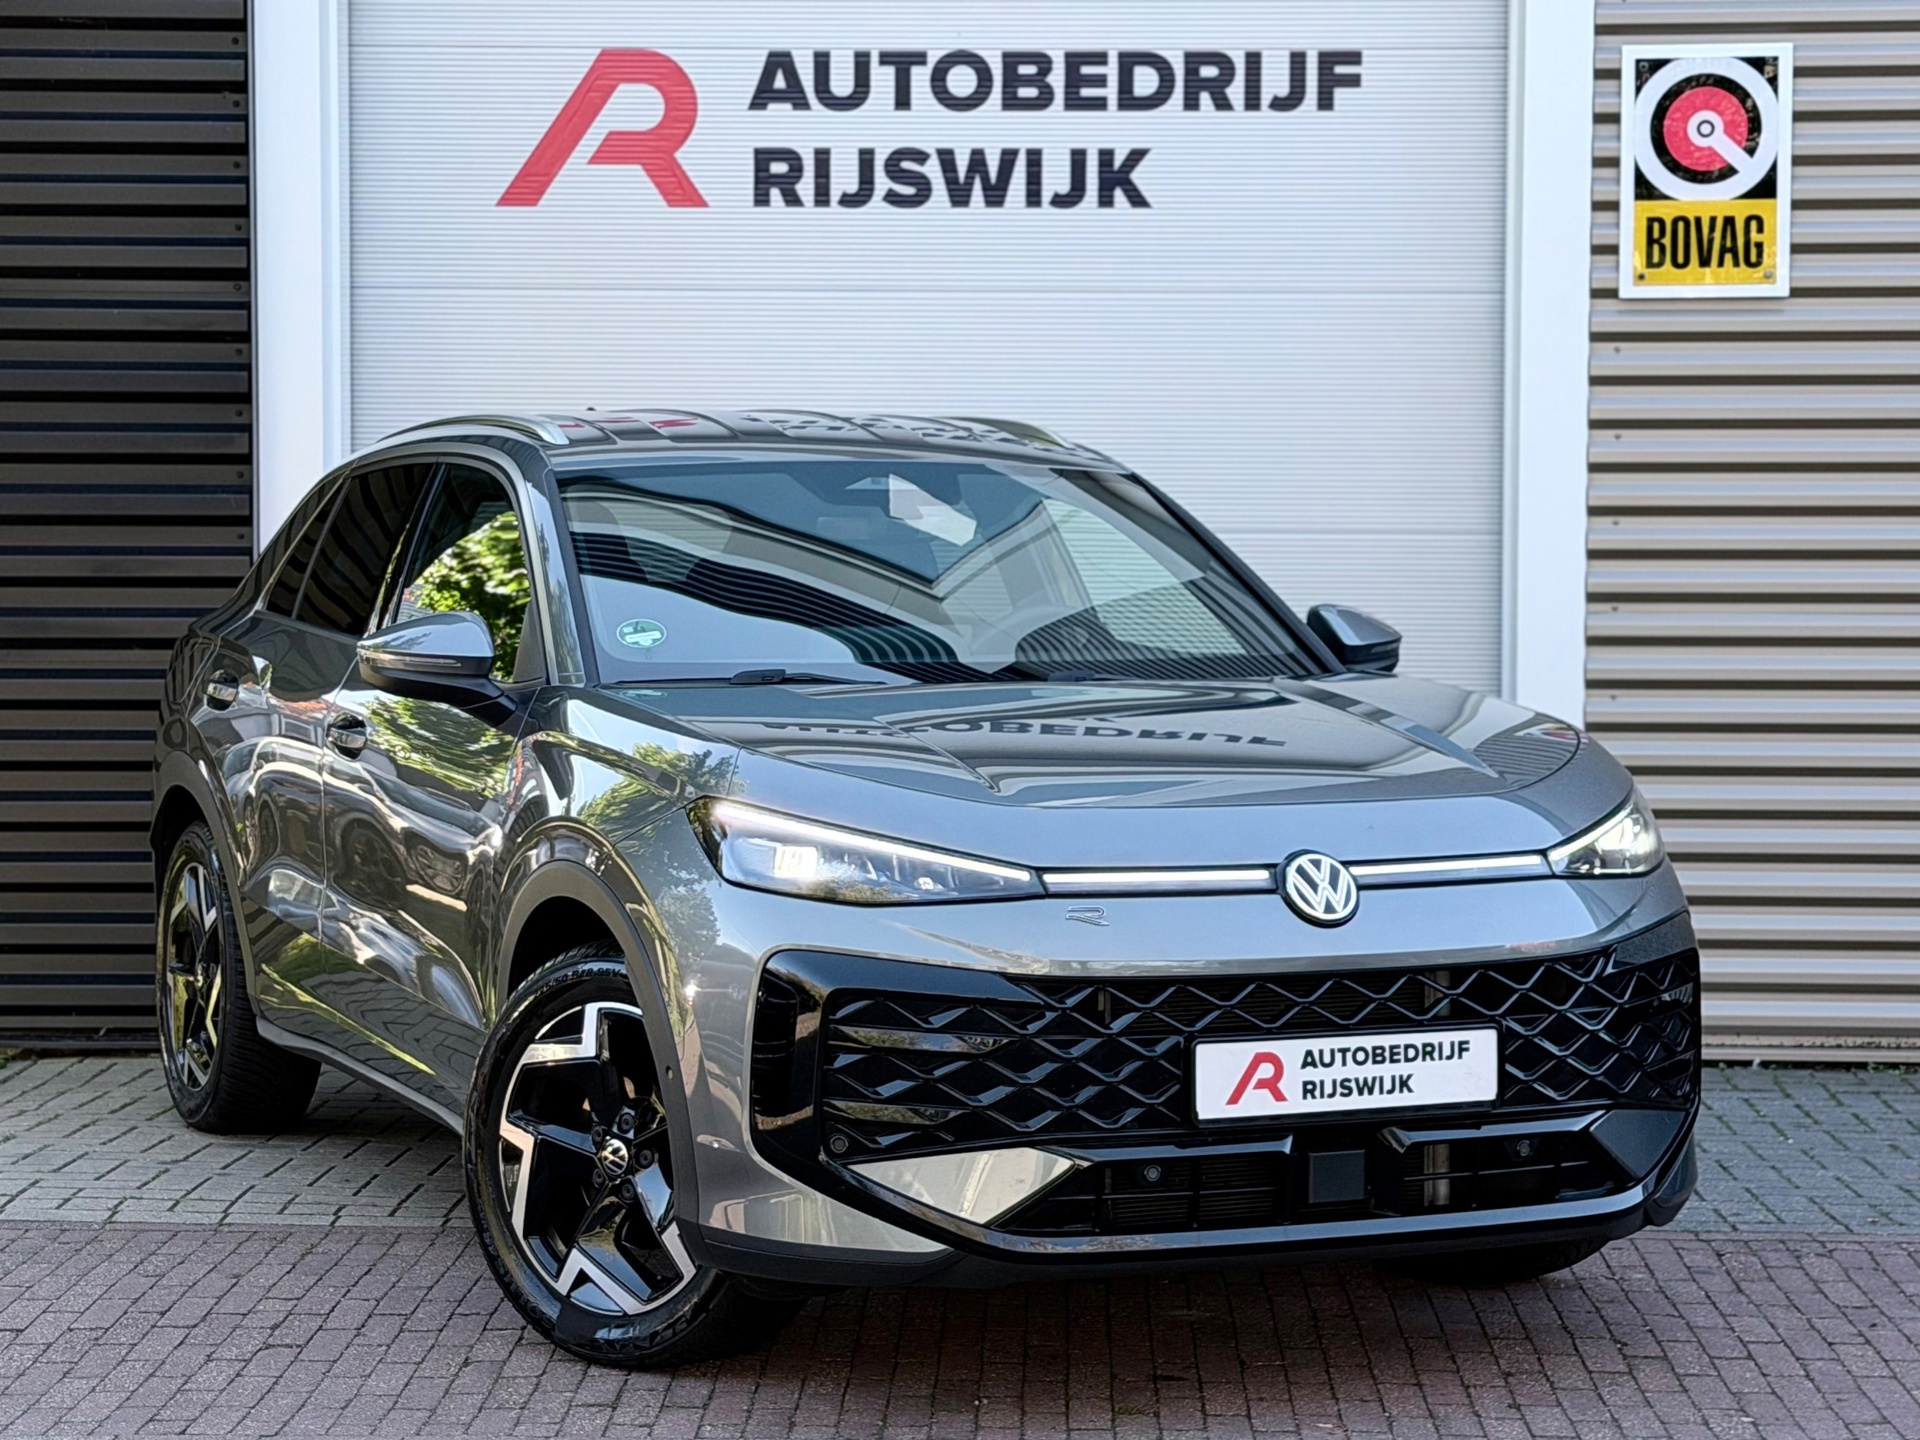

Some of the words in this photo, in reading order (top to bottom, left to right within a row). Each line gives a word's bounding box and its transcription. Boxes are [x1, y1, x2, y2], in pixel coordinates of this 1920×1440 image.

[749, 49, 1362, 112] AUTOBEDRIJF
[753, 147, 1152, 209] RIJSWIJK
[1645, 214, 1765, 270] BOVAG
[1300, 1040, 1470, 1070] AUTOBEDRIJF
[1302, 1073, 1415, 1101] RIJSWIJK
